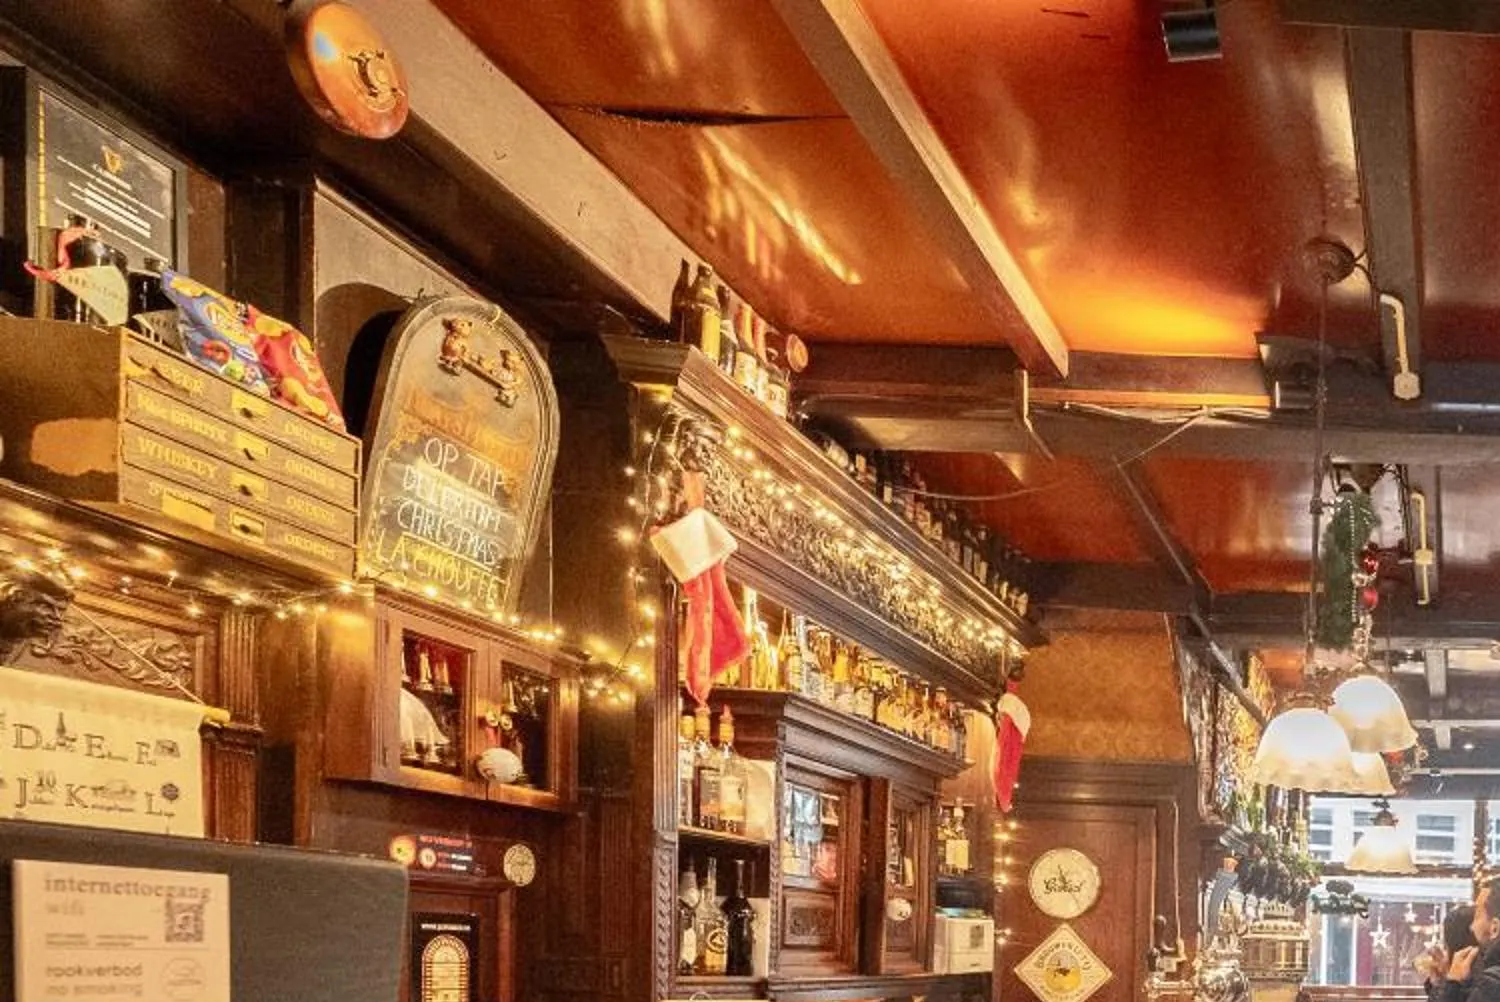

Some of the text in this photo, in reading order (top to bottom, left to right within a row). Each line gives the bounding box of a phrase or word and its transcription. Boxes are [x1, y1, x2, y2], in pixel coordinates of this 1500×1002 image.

[425, 438, 505, 496] OP TAP
[376, 529, 407, 563] LA
[397, 501, 500, 565] CHRISTMAS
[45, 872, 212, 901] internettoegang
[47, 963, 143, 977] rookverbod
